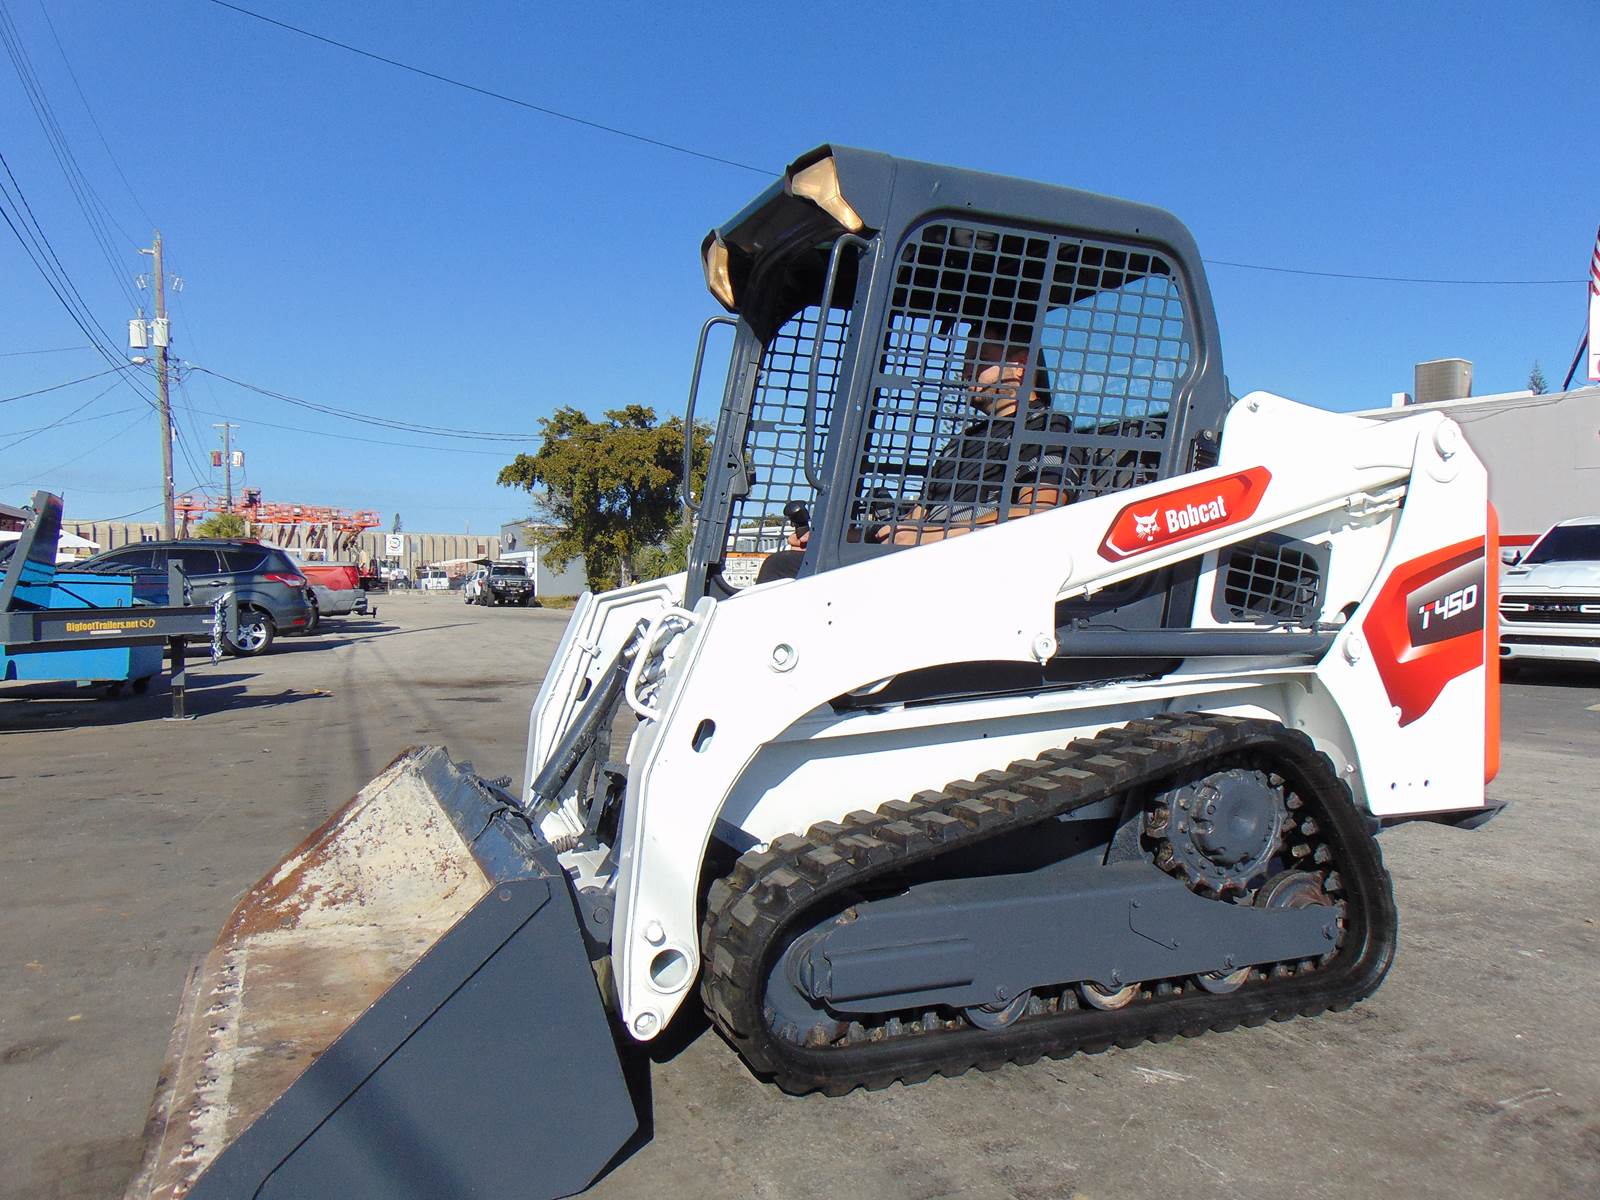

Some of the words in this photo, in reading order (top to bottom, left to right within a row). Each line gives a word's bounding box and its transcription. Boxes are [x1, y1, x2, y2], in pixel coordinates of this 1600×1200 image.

[1165, 495, 1227, 533] Bobcat
[1418, 584, 1478, 629] T450
[1528, 604, 1579, 612] RAM
[66, 620, 139, 632] BigfootTrailers.net
